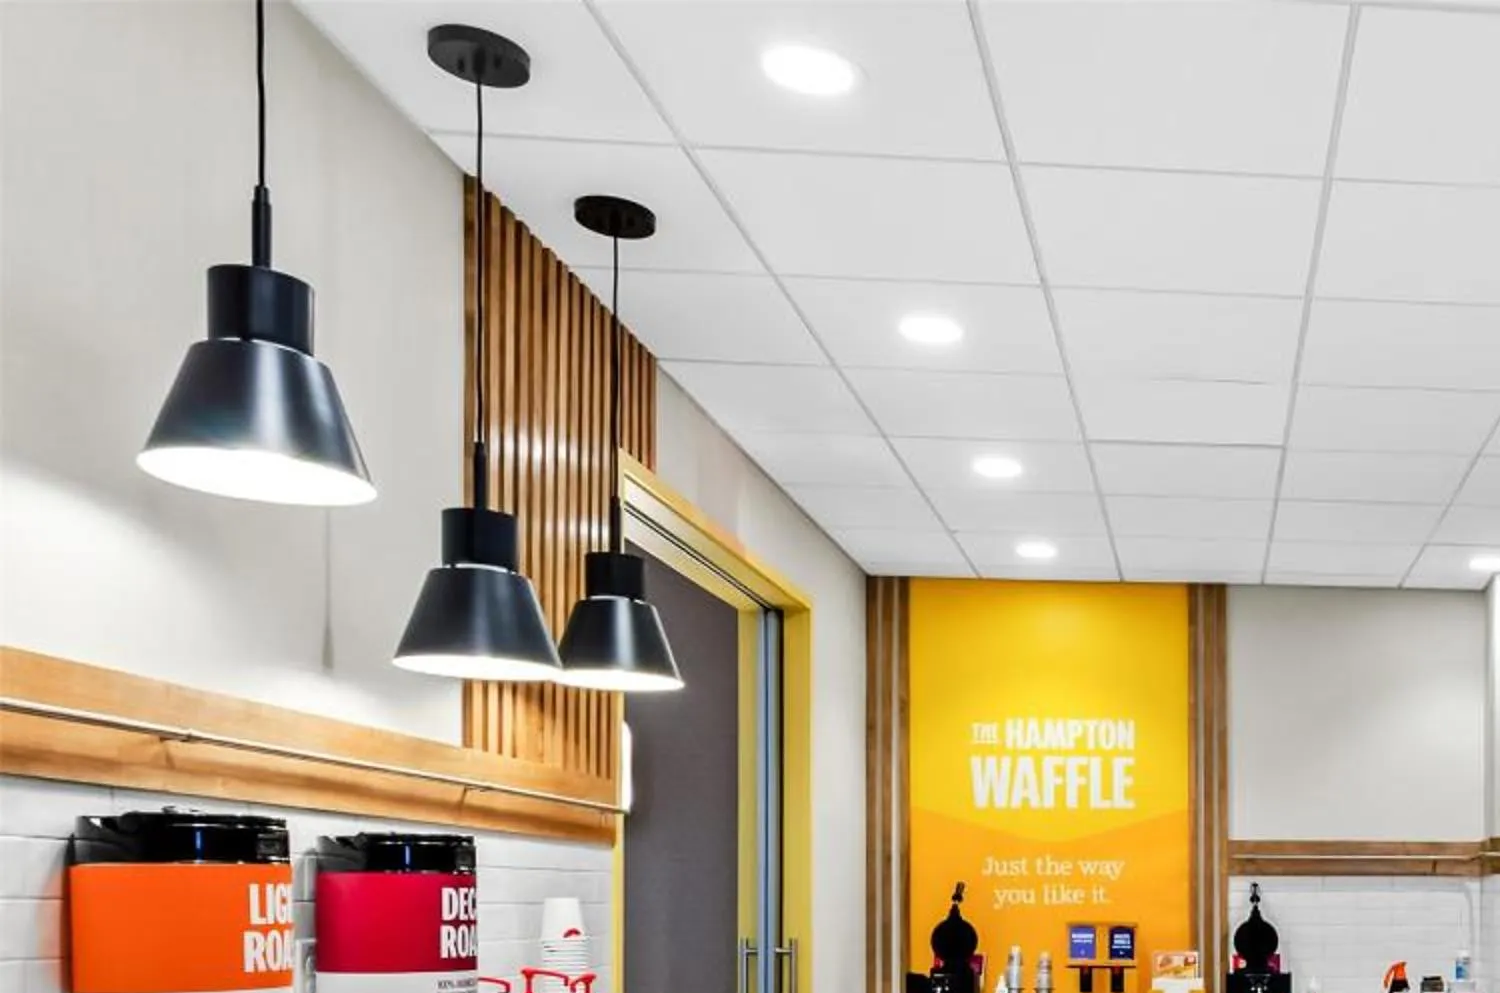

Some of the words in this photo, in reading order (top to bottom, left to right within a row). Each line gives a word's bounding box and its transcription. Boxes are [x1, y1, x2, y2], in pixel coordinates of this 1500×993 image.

[972, 722, 999, 744] THE
[1005, 717, 1136, 750] HAMPTON
[970, 755, 1136, 810] WAFFLE
[982, 856, 1028, 876] Just
[1036, 855, 1073, 876] the
[1079, 860, 1125, 880] way
[993, 888, 1036, 910] you
[1043, 884, 1085, 905] like
